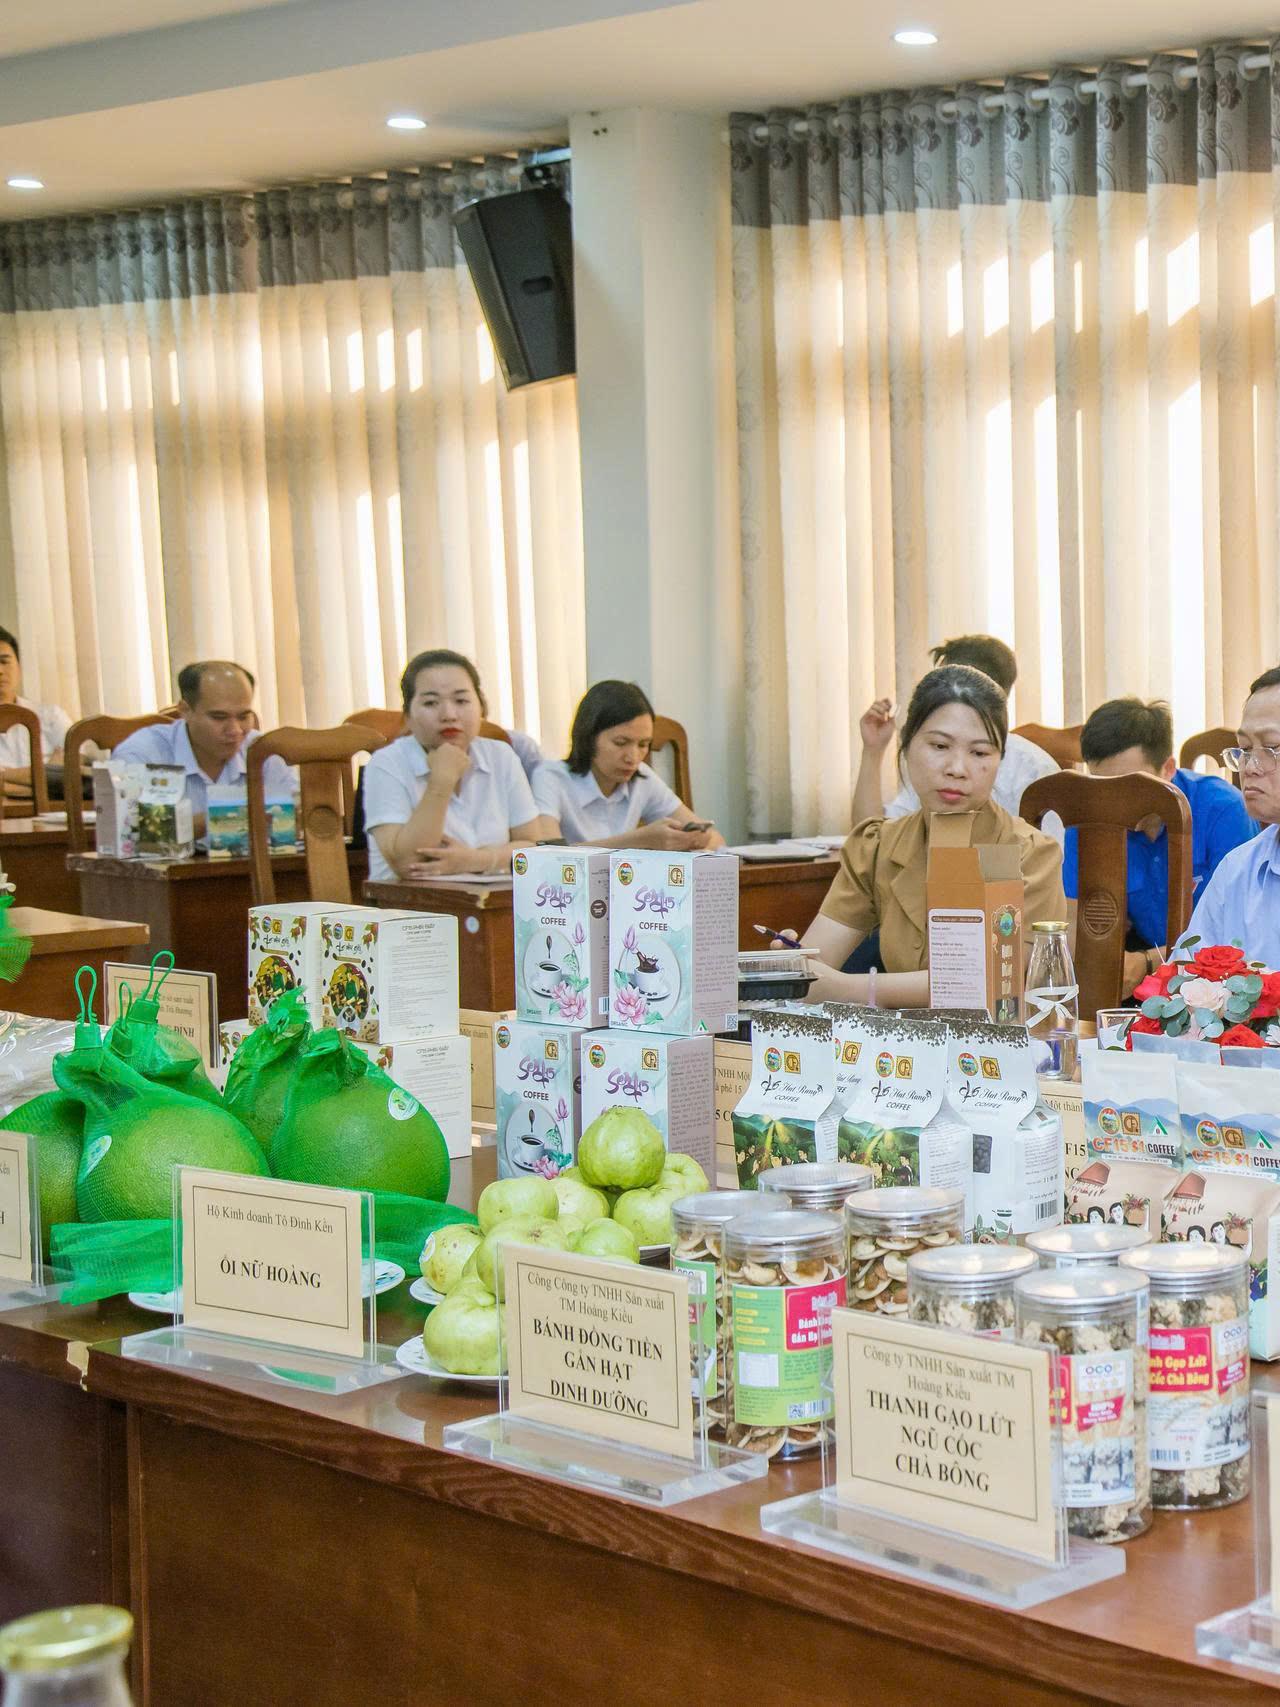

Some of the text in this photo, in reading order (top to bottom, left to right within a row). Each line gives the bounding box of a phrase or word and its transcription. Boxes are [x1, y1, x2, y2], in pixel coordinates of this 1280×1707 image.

[541, 917, 566, 926] COFFEE
[639, 921, 668, 931] COFFEE
[523, 1090, 549, 1101] COFFEE
[775, 1094, 800, 1102] COFFEE
[886, 1101, 912, 1111] COFFEE
[974, 1101, 1002, 1109] COFFEE
[1065, 1143, 1086, 1157] F15
[1092, 1137, 1129, 1153] CF15
[1147, 1143, 1175, 1155] COFFEE
[1191, 1148, 1232, 1168] CF15
[207, 1204, 220, 1219] Hộ
[222, 1206, 244, 1221] Kinh
[246, 1209, 273, 1226] doanh
[275, 1214, 288, 1227] Tô
[240, 1259, 264, 1279] NỮ
[267, 1264, 322, 1289] HOÀNG
[527, 1271, 665, 1311] Công Công ty TNHH Sản xuất
[559, 1297, 633, 1325] TM Hoàng Kiều
[533, 1315, 663, 1361] BÁNH ĐỒNG TIỀN
[600, 1358, 633, 1383] HẠT
[863, 1344, 1015, 1389] Công ty TNHH Sản xuất TM
[907, 1375, 943, 1398] Hoàng
[550, 1379, 649, 1418] DINH DƯỠNG
[866, 1389, 1016, 1439] THANH GẠO LỨT
[900, 1425, 983, 1461] NGŨ CỐC
[895, 1453, 990, 1492] CHÀ BÔNG
